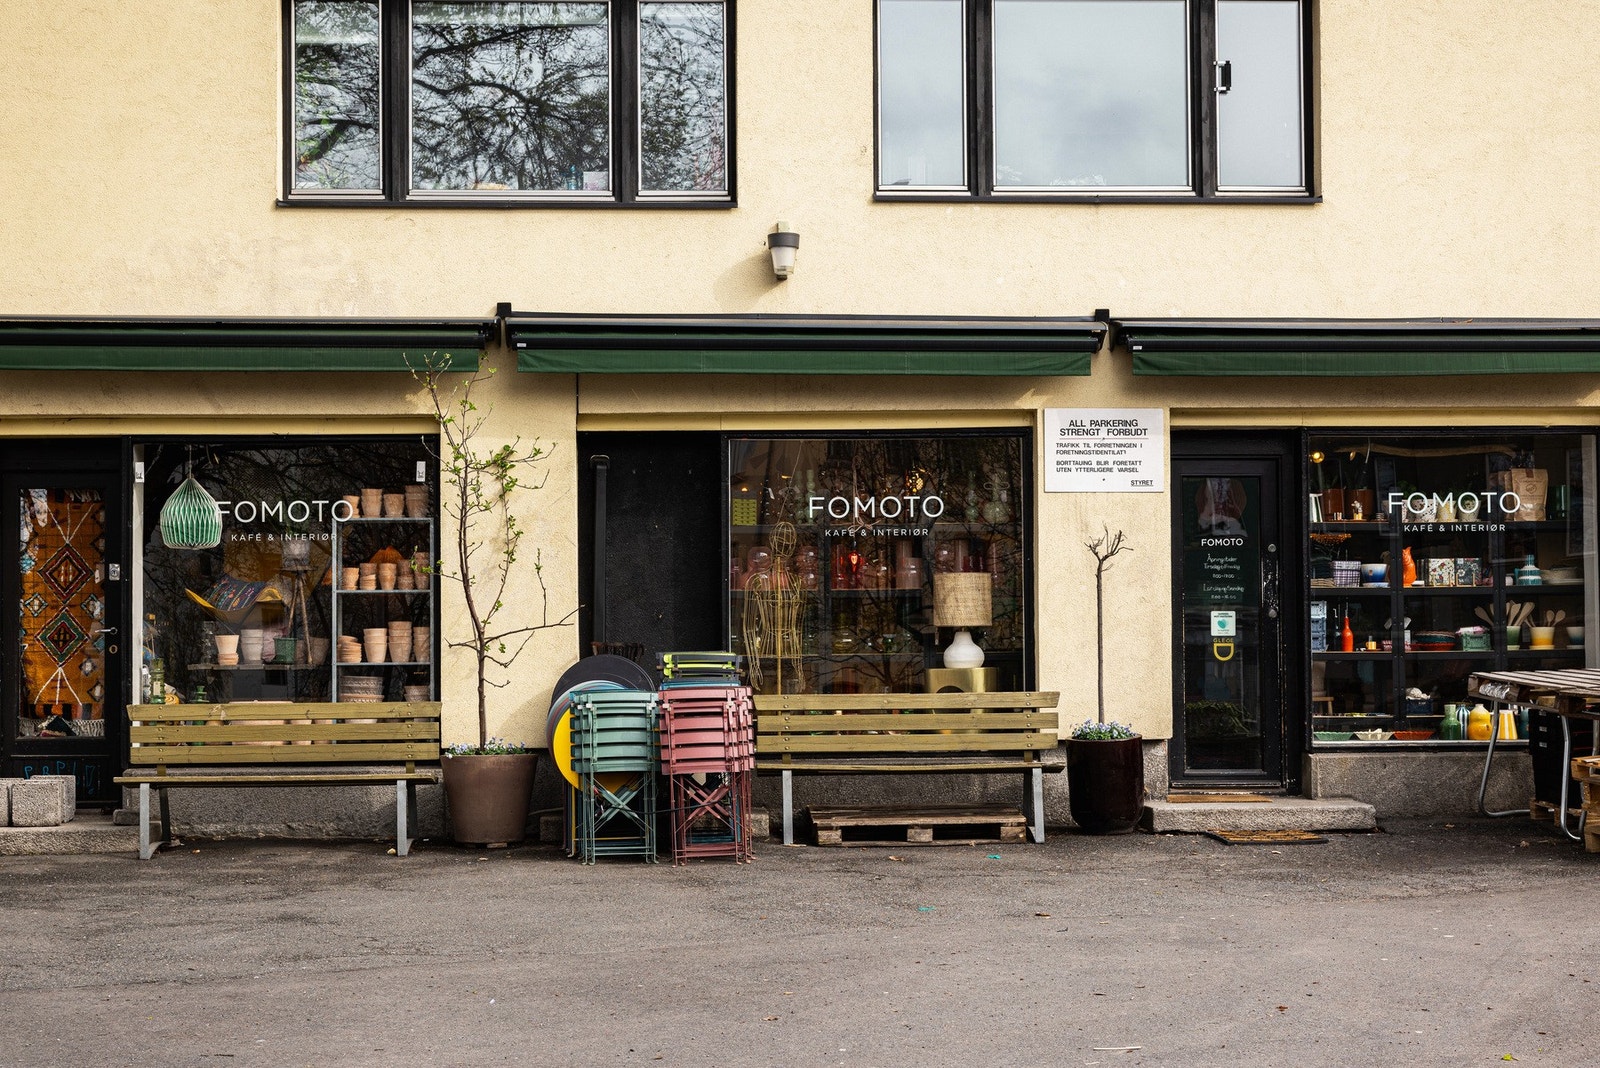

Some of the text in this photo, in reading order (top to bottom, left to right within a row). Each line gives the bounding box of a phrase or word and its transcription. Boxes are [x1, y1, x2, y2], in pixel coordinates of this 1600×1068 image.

[1069, 419, 1138, 427] ALL PARKERING
[1060, 428, 1148, 436] STRENGT FORBUDT
[809, 495, 944, 519] FOMOTO
[1388, 491, 1520, 514] FOMOTO
[215, 499, 354, 523] FOMOTO
[873, 528, 929, 536] INTERIØR
[1404, 523, 1506, 532] KAFÉ & INTERIØR
[231, 532, 337, 542] KAFÉ & INTERIØR
[1201, 538, 1244, 547] FOMOTO
